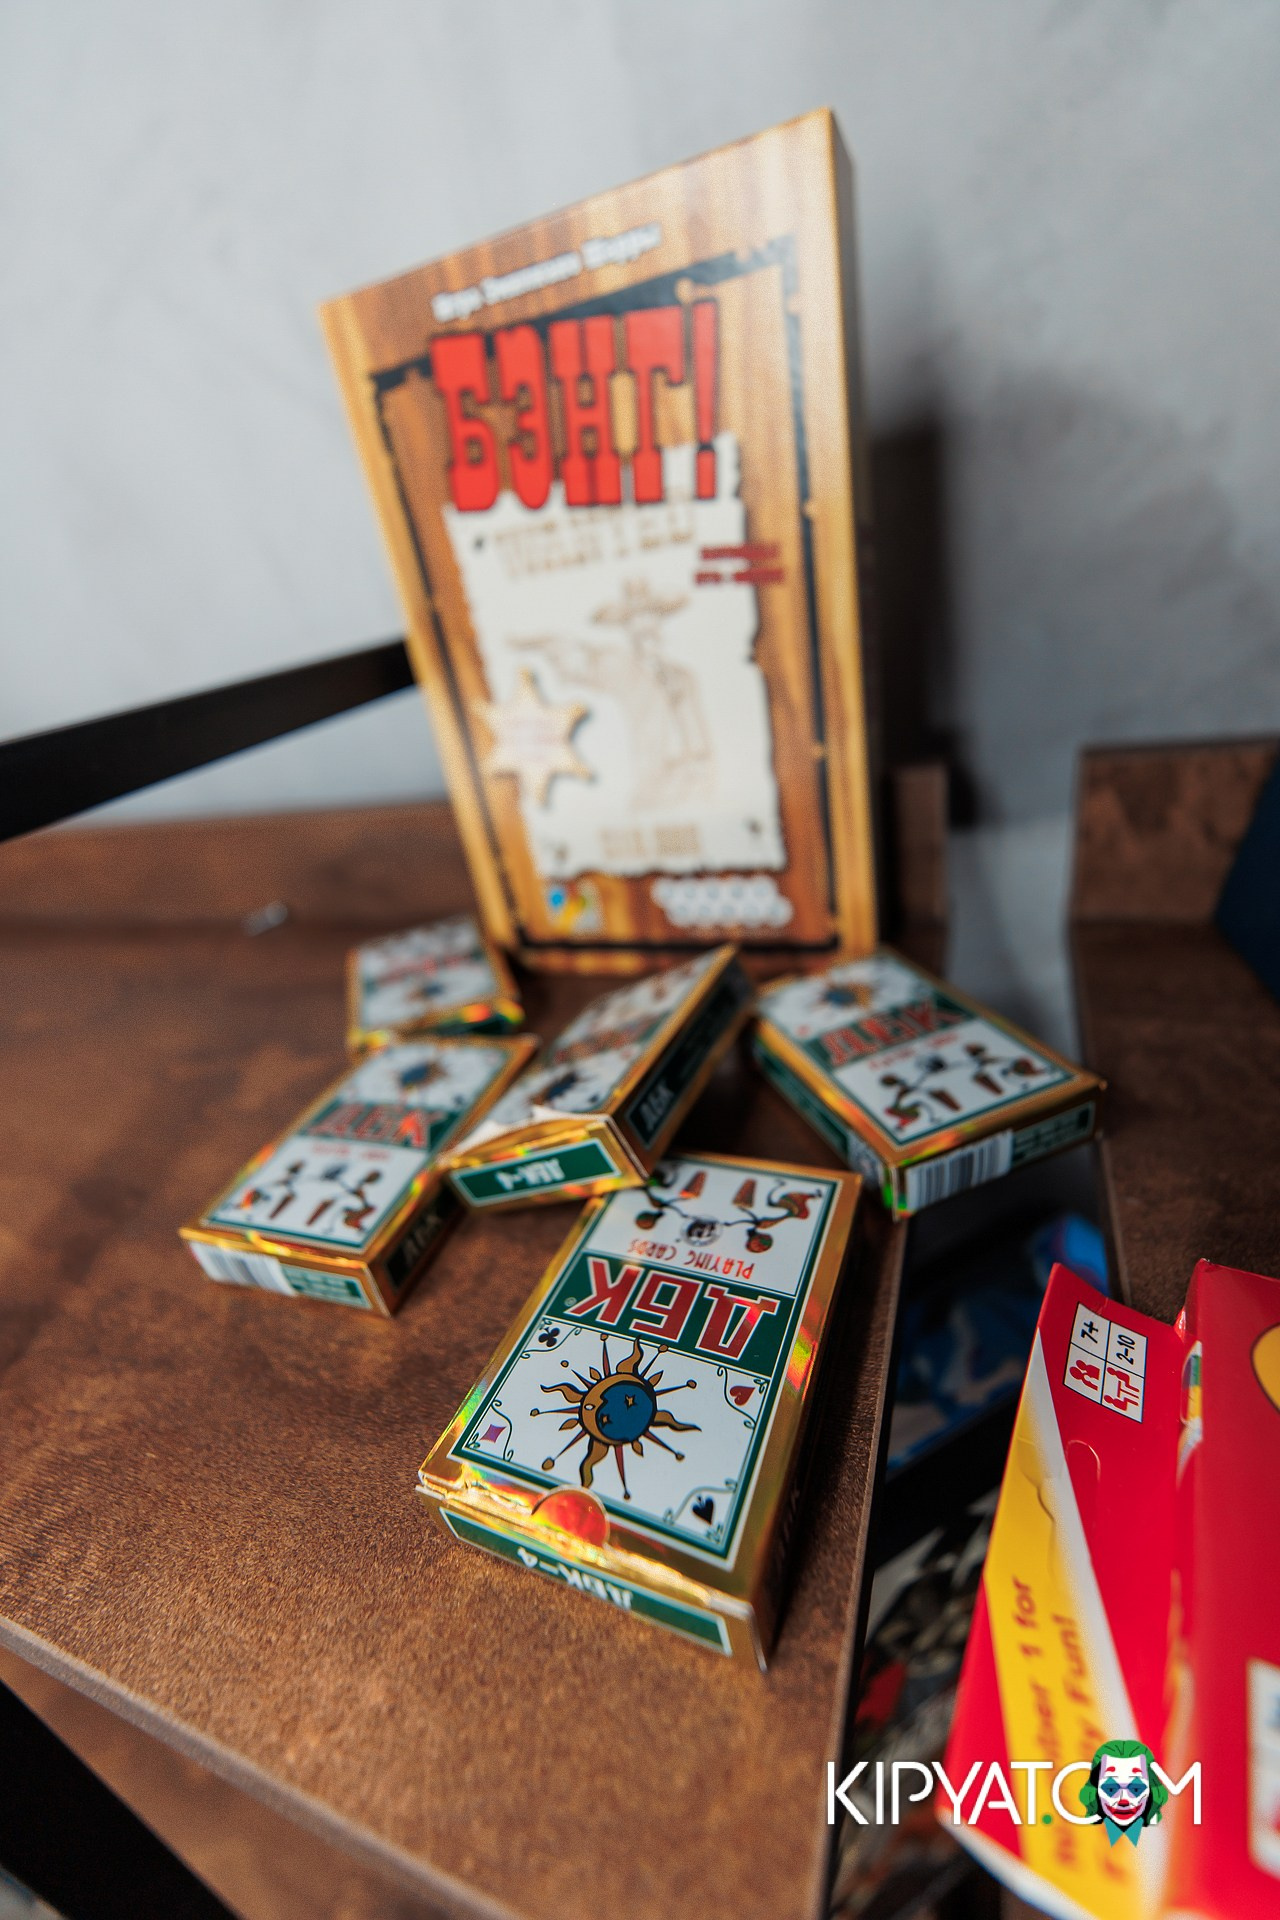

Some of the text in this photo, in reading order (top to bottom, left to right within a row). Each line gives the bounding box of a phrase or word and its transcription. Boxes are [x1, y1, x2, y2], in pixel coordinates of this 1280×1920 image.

[430, 299, 717, 513] БЭНГ!
[627, 1238, 755, 1279] PLAYING CARDS
[564, 1257, 780, 1361] ДБК
[1080, 1320, 1099, 1344] 7+
[1116, 1334, 1136, 1365] 2-10
[1012, 1574, 1038, 1630] for
